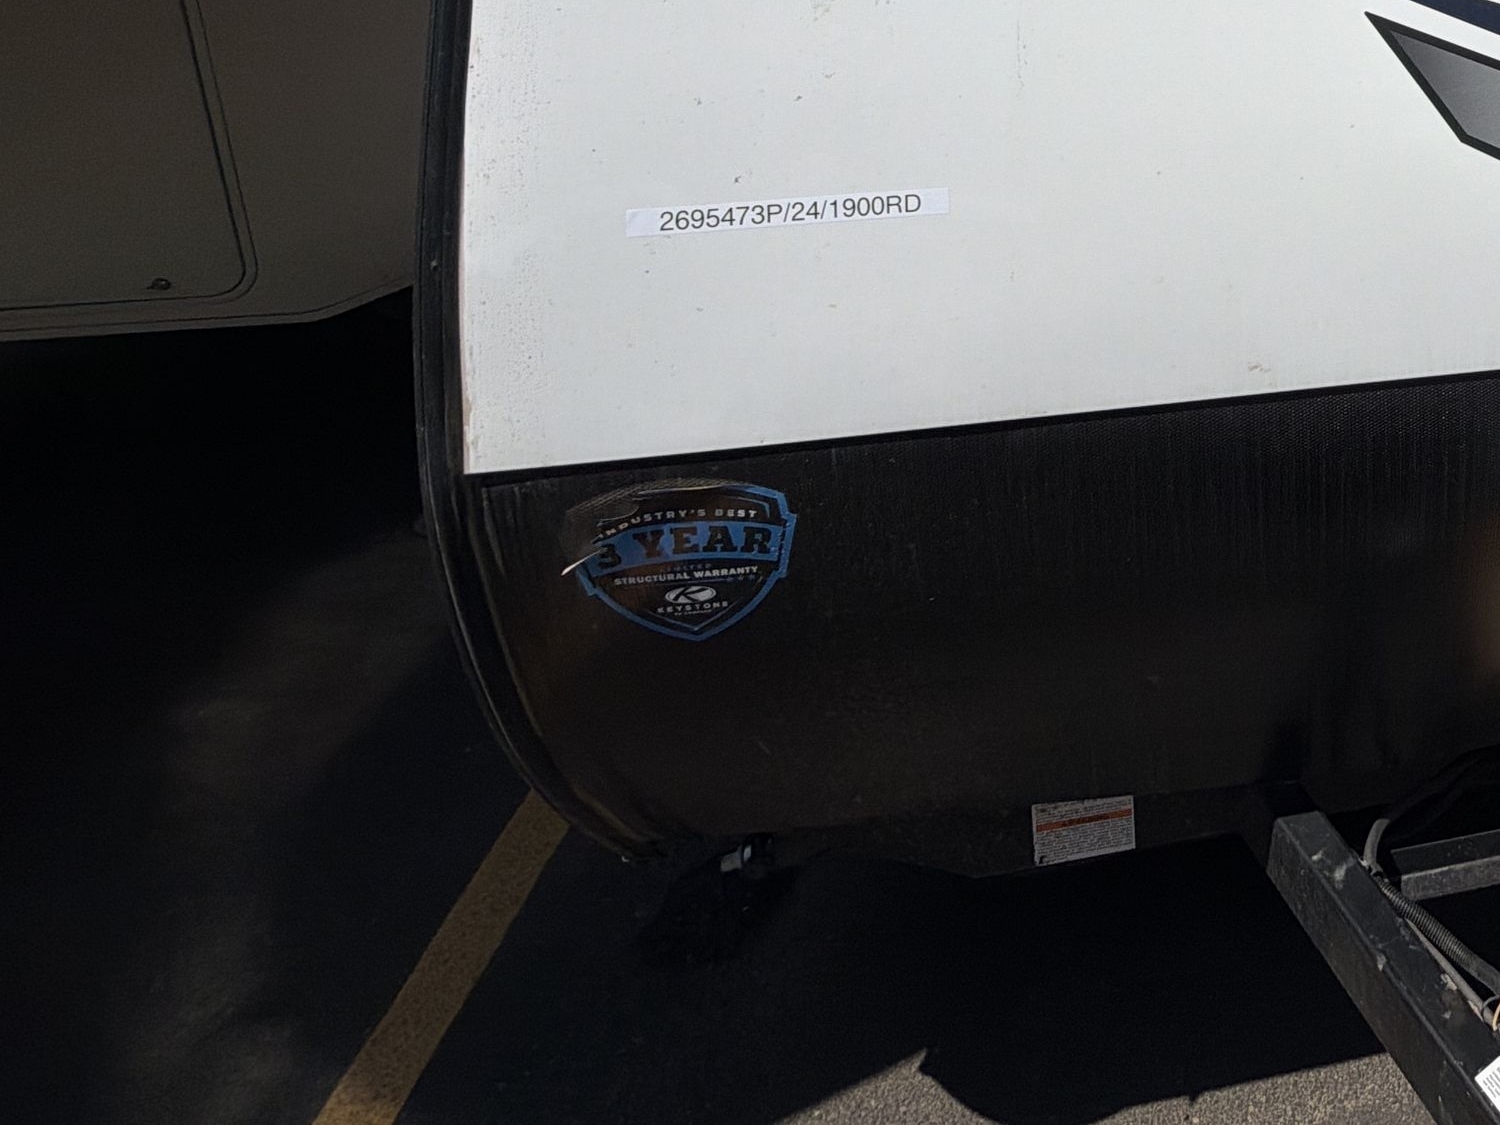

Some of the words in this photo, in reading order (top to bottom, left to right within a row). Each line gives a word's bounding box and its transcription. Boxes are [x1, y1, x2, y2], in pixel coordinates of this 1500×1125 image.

[659, 193, 922, 231] 2695473P/24/1900RD
[715, 508, 758, 518] BEST
[632, 526, 773, 559] YEAR
[613, 571, 691, 586] STRUCTURAL
[693, 565, 759, 579] WARRANTY
[656, 600, 730, 614] KEYSTONE
